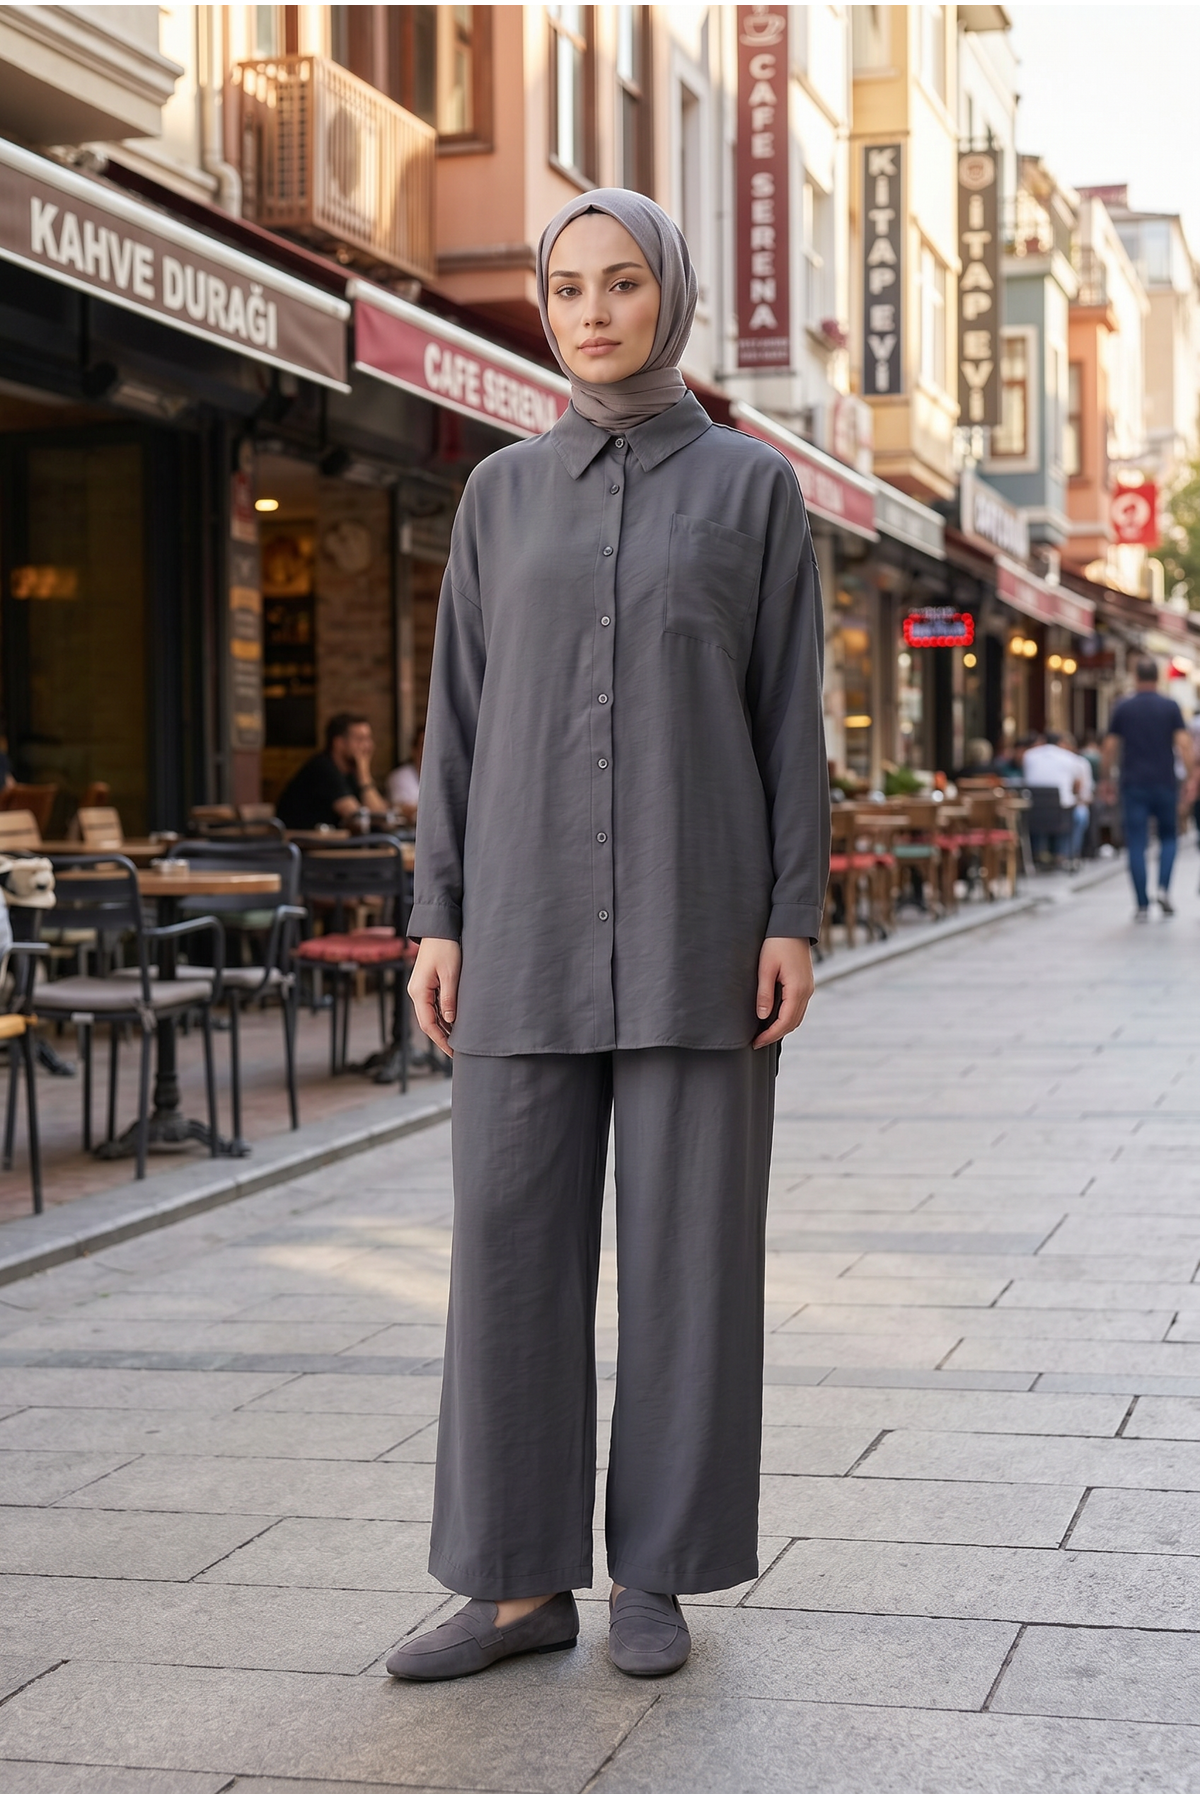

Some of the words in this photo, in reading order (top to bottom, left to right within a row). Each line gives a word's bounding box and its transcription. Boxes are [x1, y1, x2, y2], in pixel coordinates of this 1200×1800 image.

[748, 53, 778, 160] CAFE
[30, 196, 155, 301] KAHVE
[161, 254, 278, 350] DURAĞI
[749, 171, 778, 330] SERENA
[424, 341, 482, 408] CAFE
[481, 367, 558, 433] SERENA
